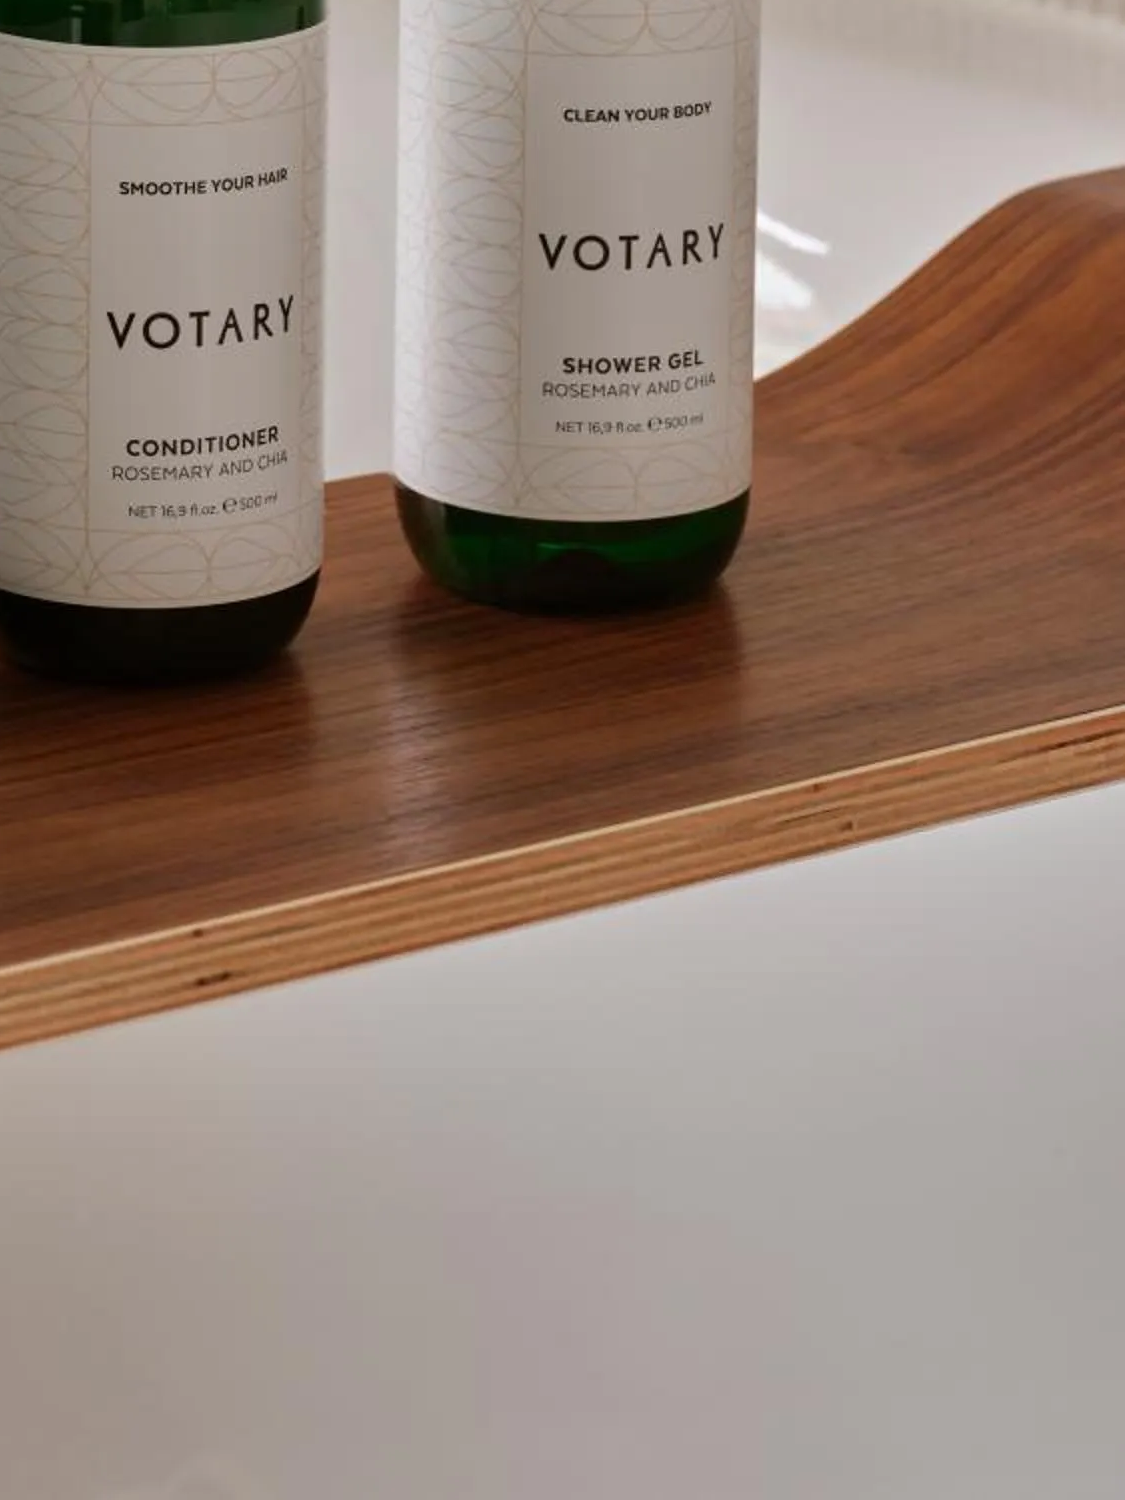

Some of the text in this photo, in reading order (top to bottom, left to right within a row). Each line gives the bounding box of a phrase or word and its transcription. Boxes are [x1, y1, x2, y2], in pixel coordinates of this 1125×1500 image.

[563, 100, 712, 123] CLEAN YOUR BODY
[118, 167, 288, 196] SMOOTHE YOUR HAIR
[538, 222, 724, 271] VOTARY
[106, 294, 294, 350] VOTARY
[562, 349, 706, 375] SHOWER GEL
[541, 371, 717, 399] ROSEMARY AND CHIA
[555, 420, 584, 433] NET
[126, 425, 279, 457] CONDITIONER
[111, 449, 288, 482] ROSEMARY AND CHIA
[128, 504, 158, 518] NET
